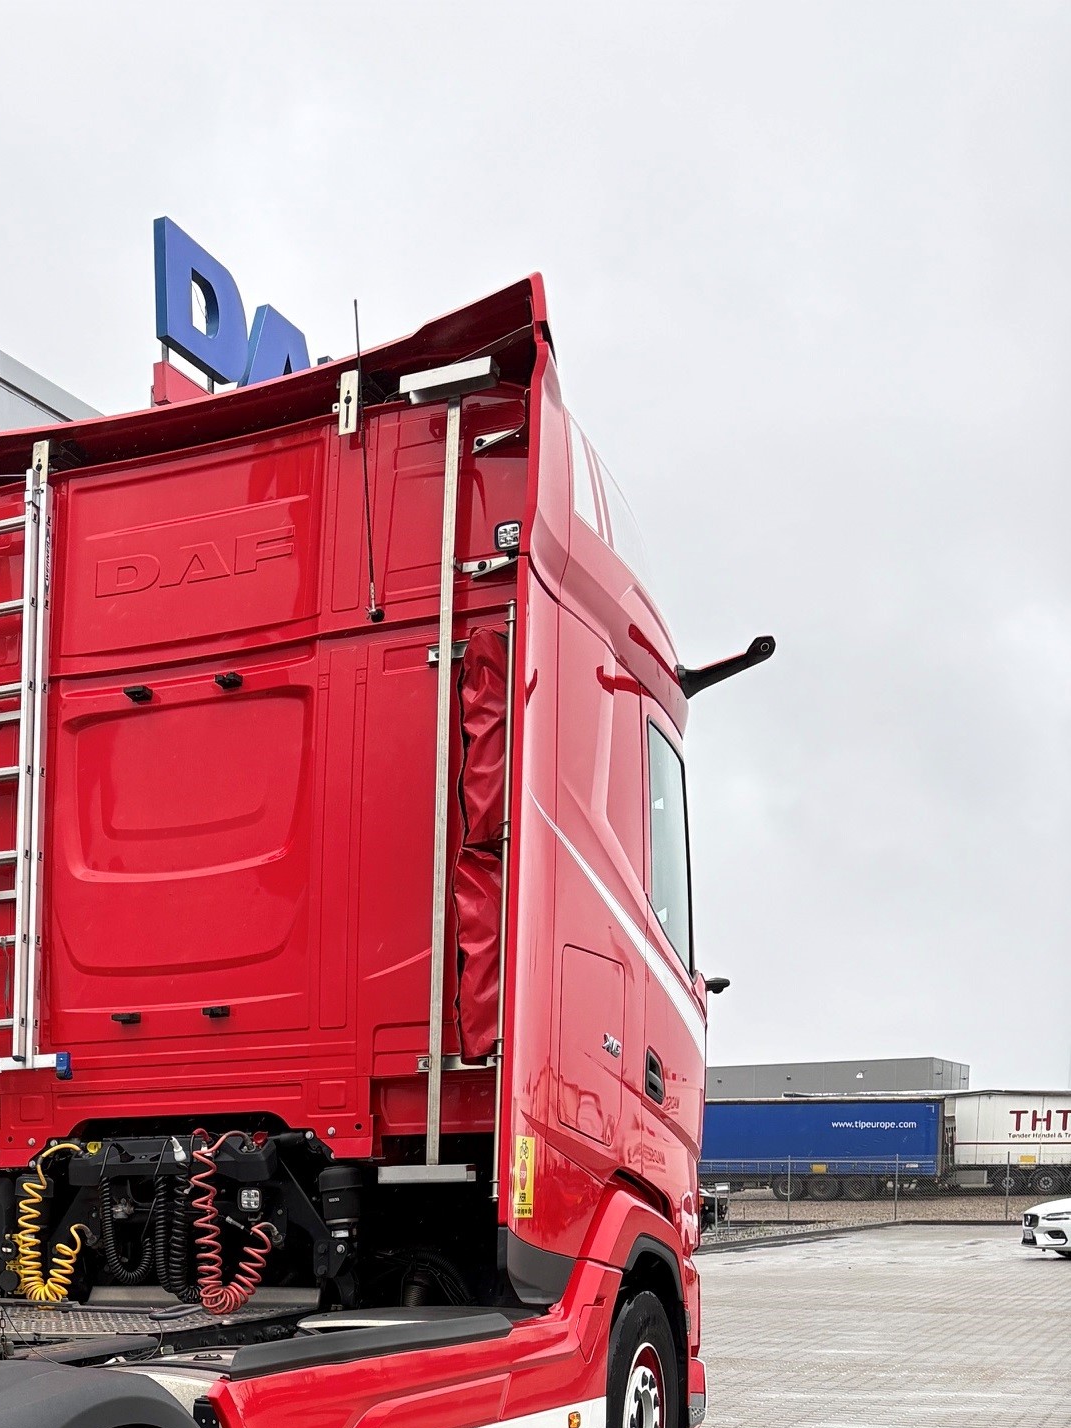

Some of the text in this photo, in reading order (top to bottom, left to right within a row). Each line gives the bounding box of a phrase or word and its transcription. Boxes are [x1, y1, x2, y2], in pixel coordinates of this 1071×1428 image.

[153, 216, 331, 387] DA
[95, 525, 296, 598] DAF
[831, 1119, 917, 1130] www.tipeurope.com
[1009, 1110, 1071, 1131] THT
